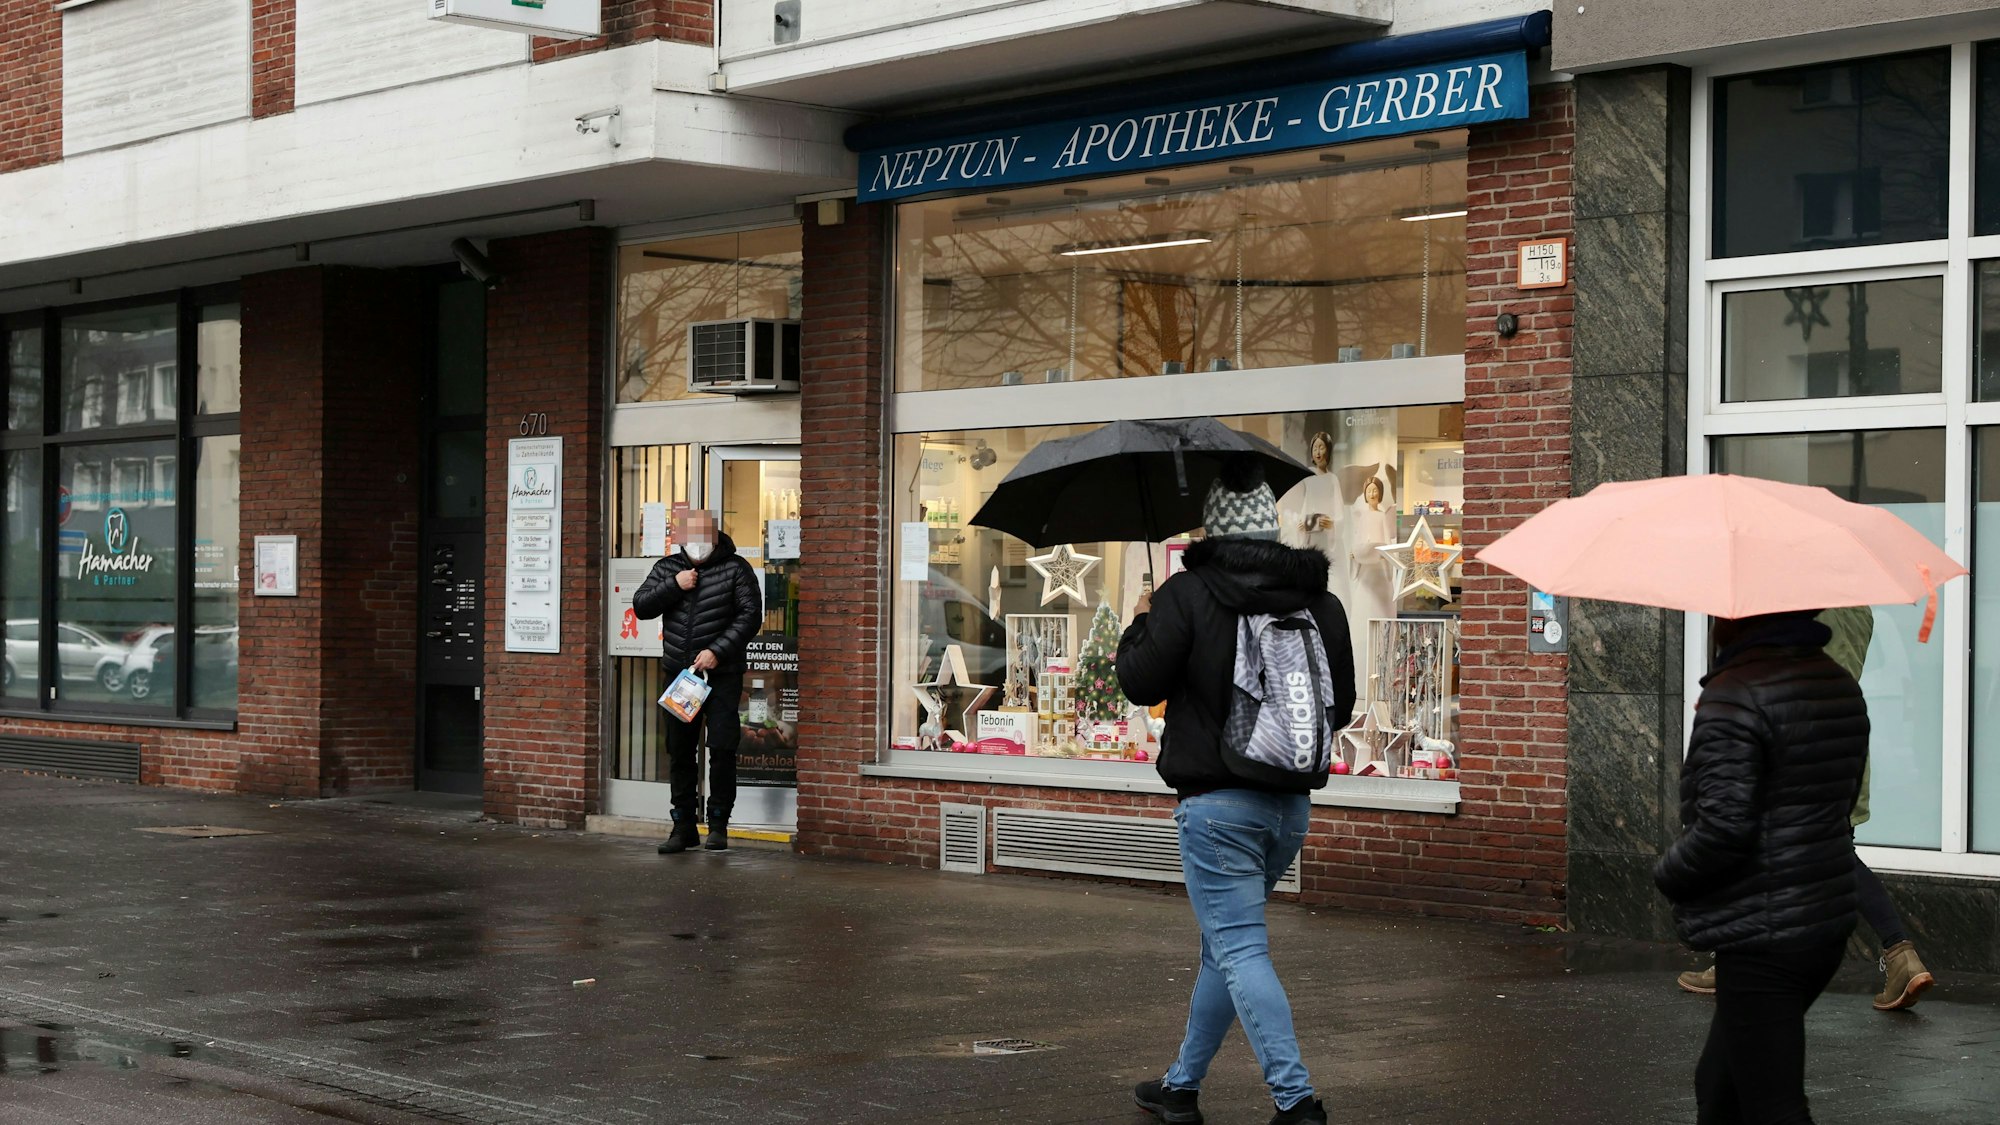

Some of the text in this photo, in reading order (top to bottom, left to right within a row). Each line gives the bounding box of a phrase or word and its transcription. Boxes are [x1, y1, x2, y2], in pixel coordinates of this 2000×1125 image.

[870, 136, 1020, 192] NEPTUN
[1052, 97, 1280, 169] APOTHEKE
[1317, 63, 1505, 133] GERBER
[519, 412, 547, 436] 670
[511, 482, 552, 500] Hamacher
[78, 536, 153, 580] Hamacher
[94, 574, 136, 586] & Partner
[746, 641, 784, 651] CKT DEN
[753, 661, 771, 671] DER
[980, 714, 1015, 726] Tebonin
[1286, 671, 1313, 769] adidas
